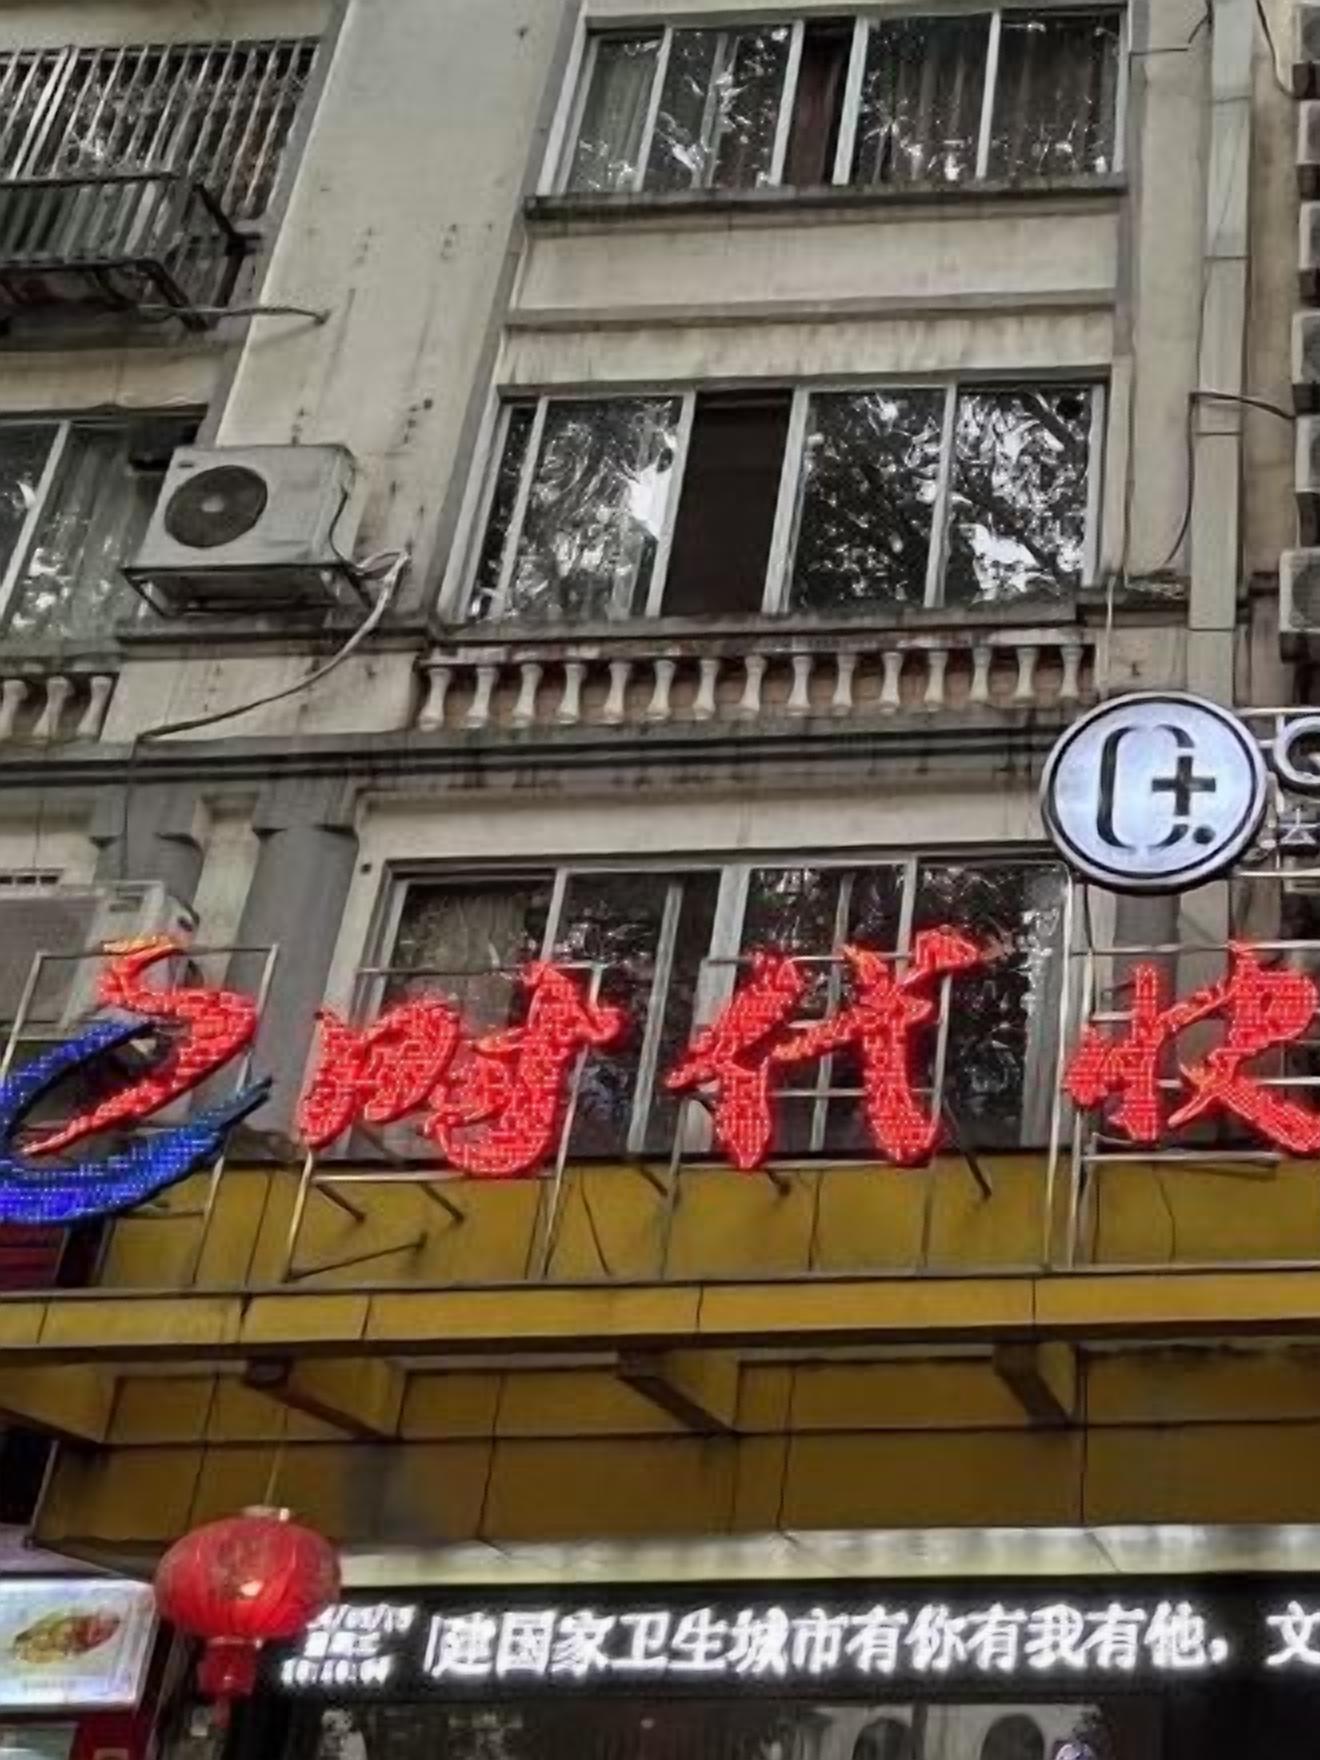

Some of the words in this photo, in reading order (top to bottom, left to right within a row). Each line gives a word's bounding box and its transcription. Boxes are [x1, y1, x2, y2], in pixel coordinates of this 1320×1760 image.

[423, 1602, 1229, 1678] 建国家卫生城市有你有我有他，
